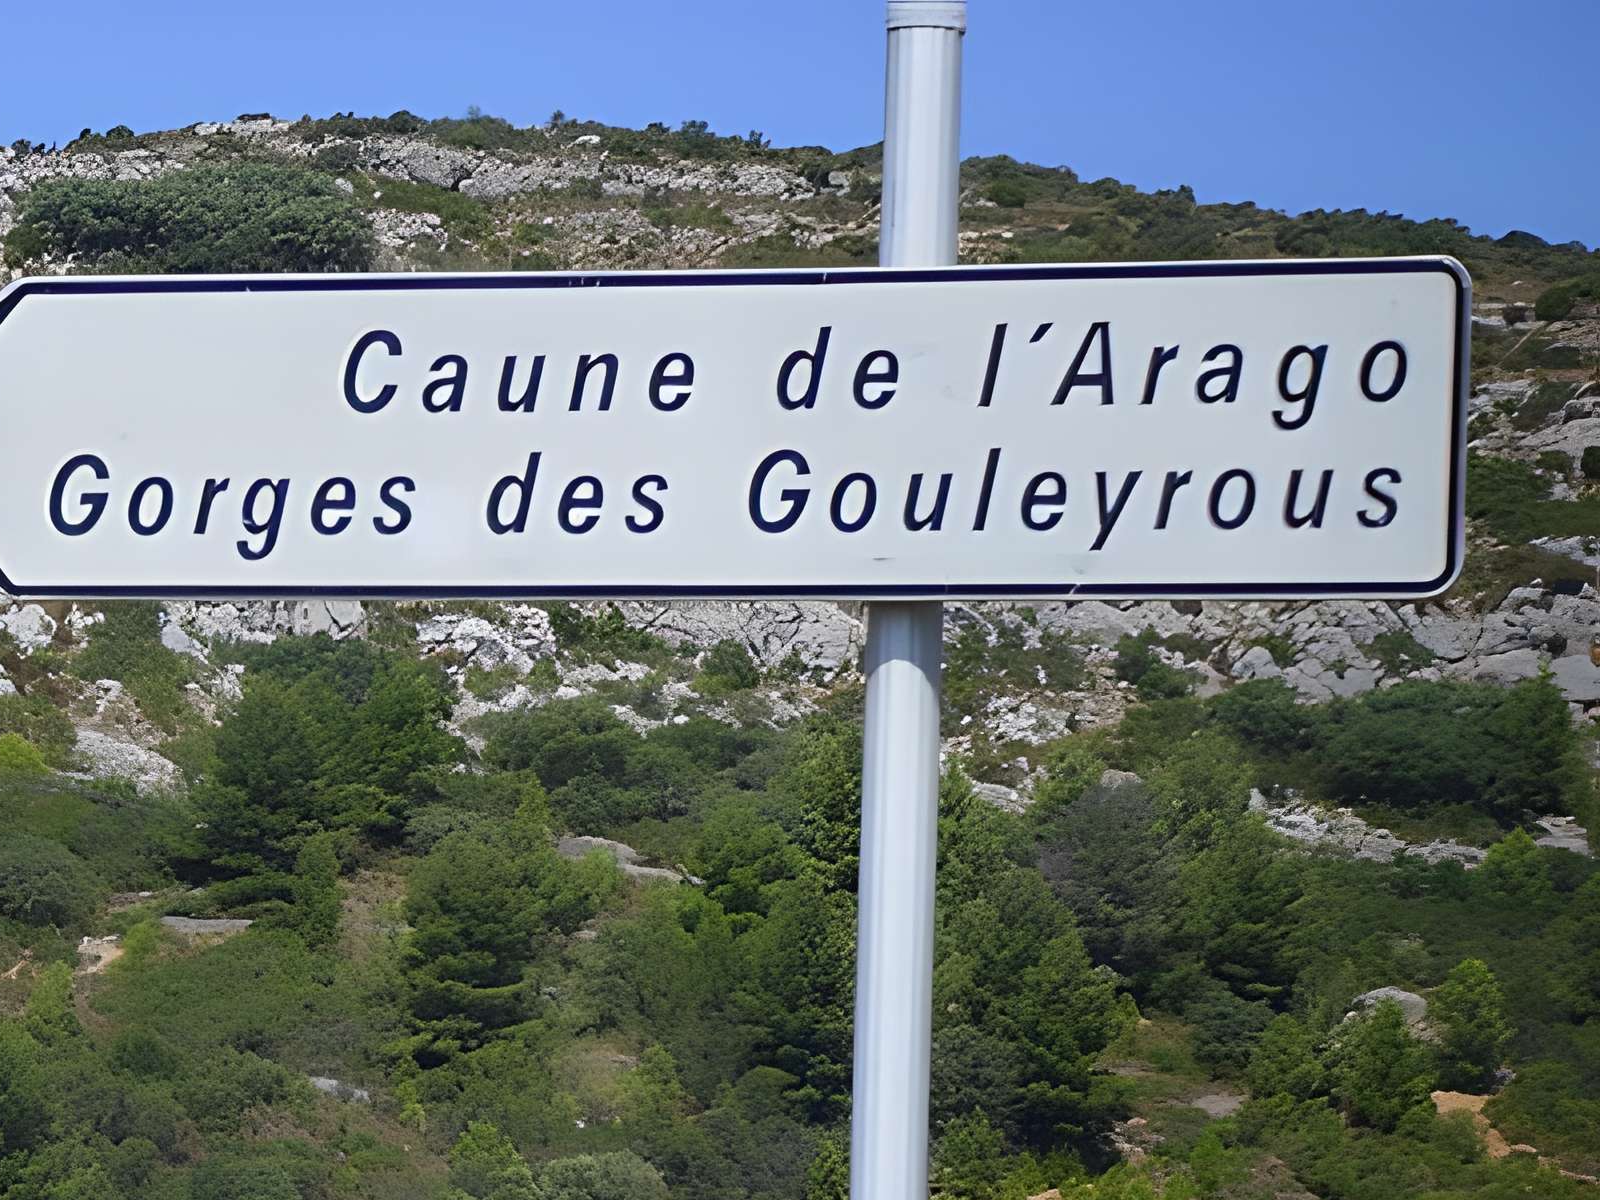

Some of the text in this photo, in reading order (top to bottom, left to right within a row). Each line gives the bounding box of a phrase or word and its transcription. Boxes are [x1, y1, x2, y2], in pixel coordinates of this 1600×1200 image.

[343, 321, 1408, 431] Caune de l'Arago
[48, 446, 1403, 561] Gorges des Gouleyrous
